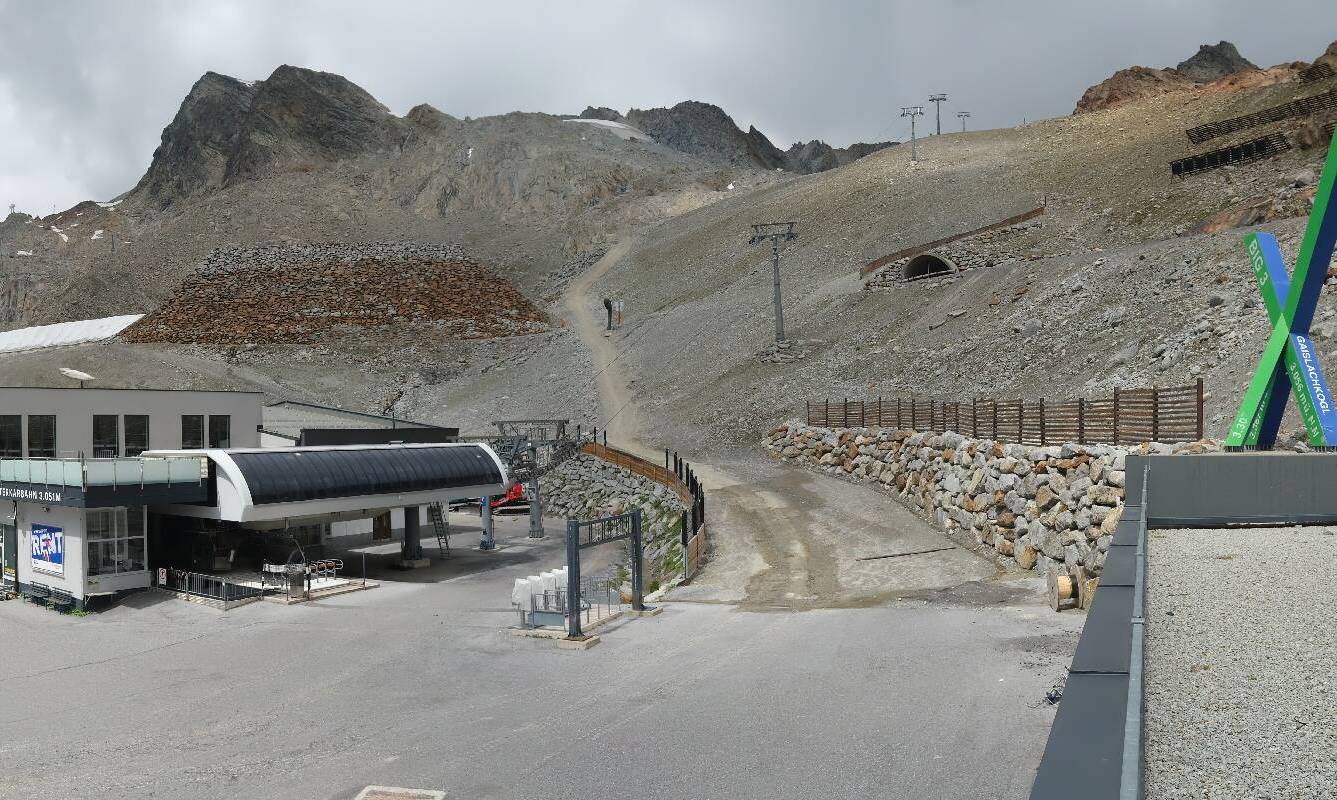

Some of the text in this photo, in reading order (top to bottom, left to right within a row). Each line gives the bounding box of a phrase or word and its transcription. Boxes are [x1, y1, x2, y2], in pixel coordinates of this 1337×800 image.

[1248, 239, 1269, 286] BIG 3
[1290, 362, 1304, 391] 3.056
[1296, 335, 1331, 416] GAISLACHKOGL
[31, 532, 63, 555] RENT
